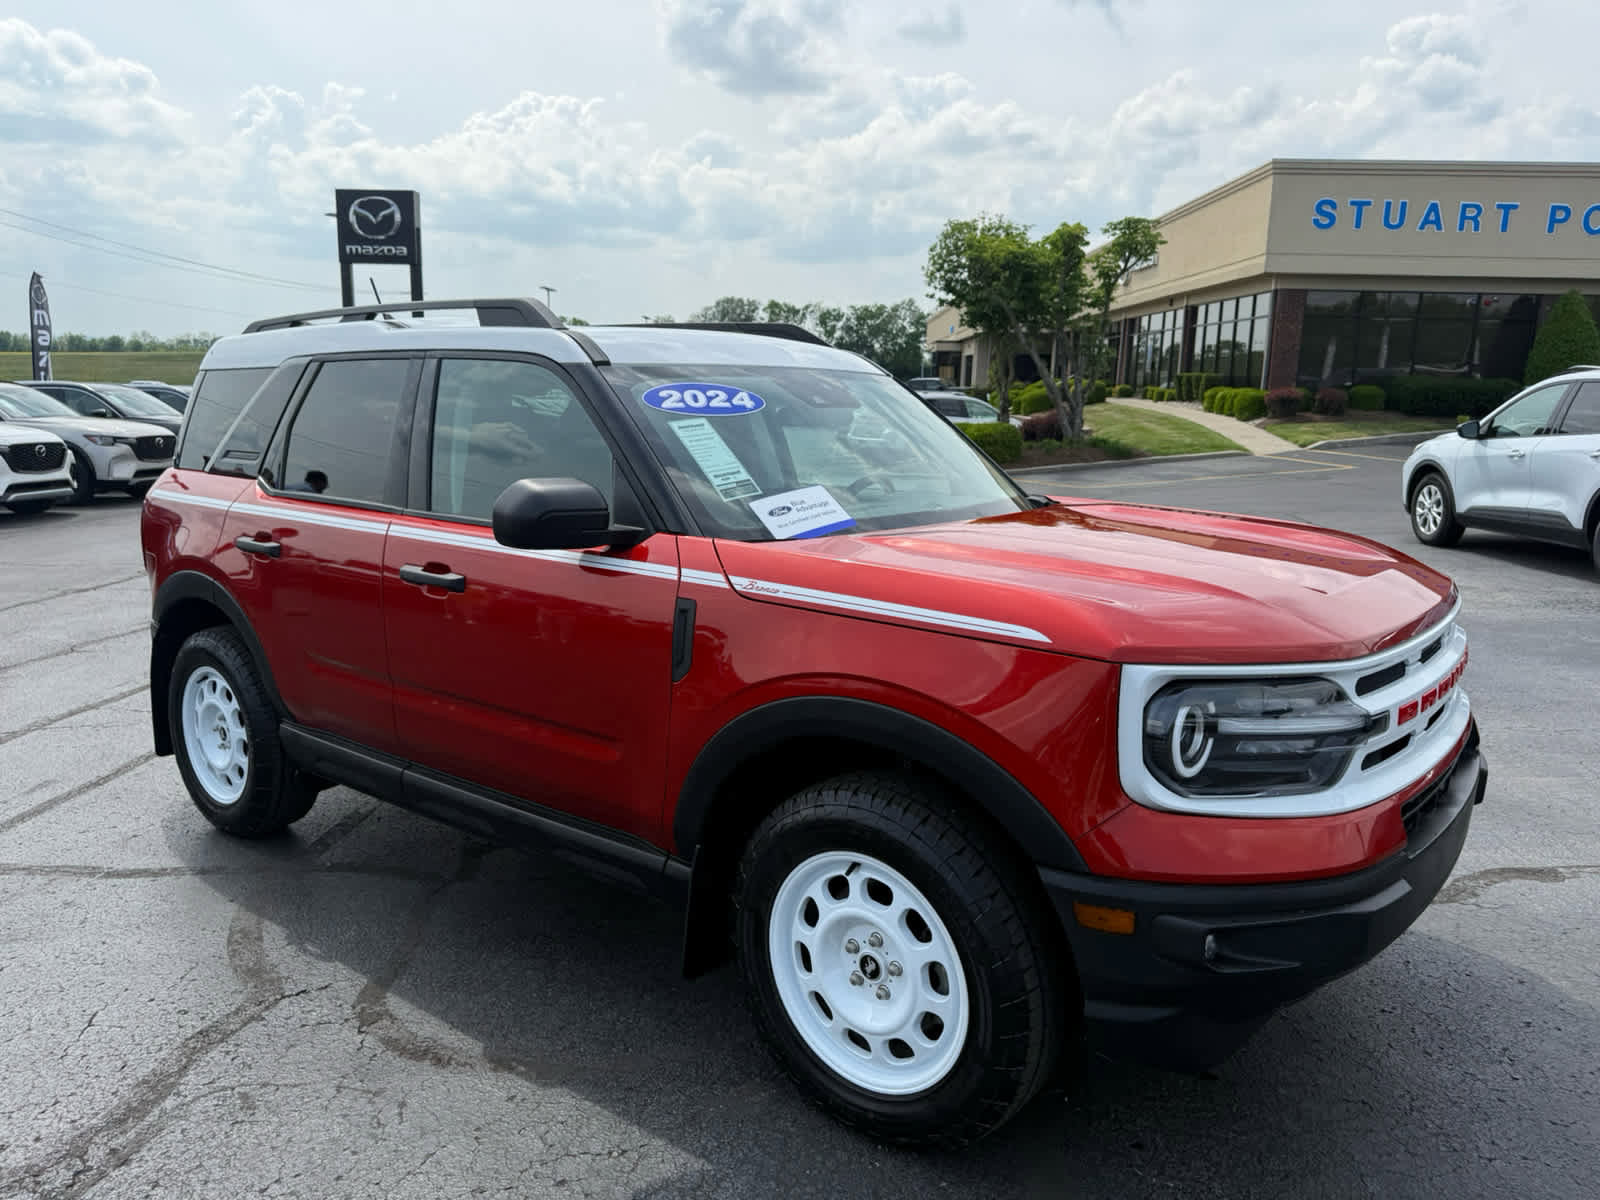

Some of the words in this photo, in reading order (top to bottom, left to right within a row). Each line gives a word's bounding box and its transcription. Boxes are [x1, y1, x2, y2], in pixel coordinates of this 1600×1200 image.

[1312, 198, 1520, 233] STUART
[345, 244, 408, 256] mazda
[33, 309, 50, 383] maz
[658, 389, 756, 409] 2024
